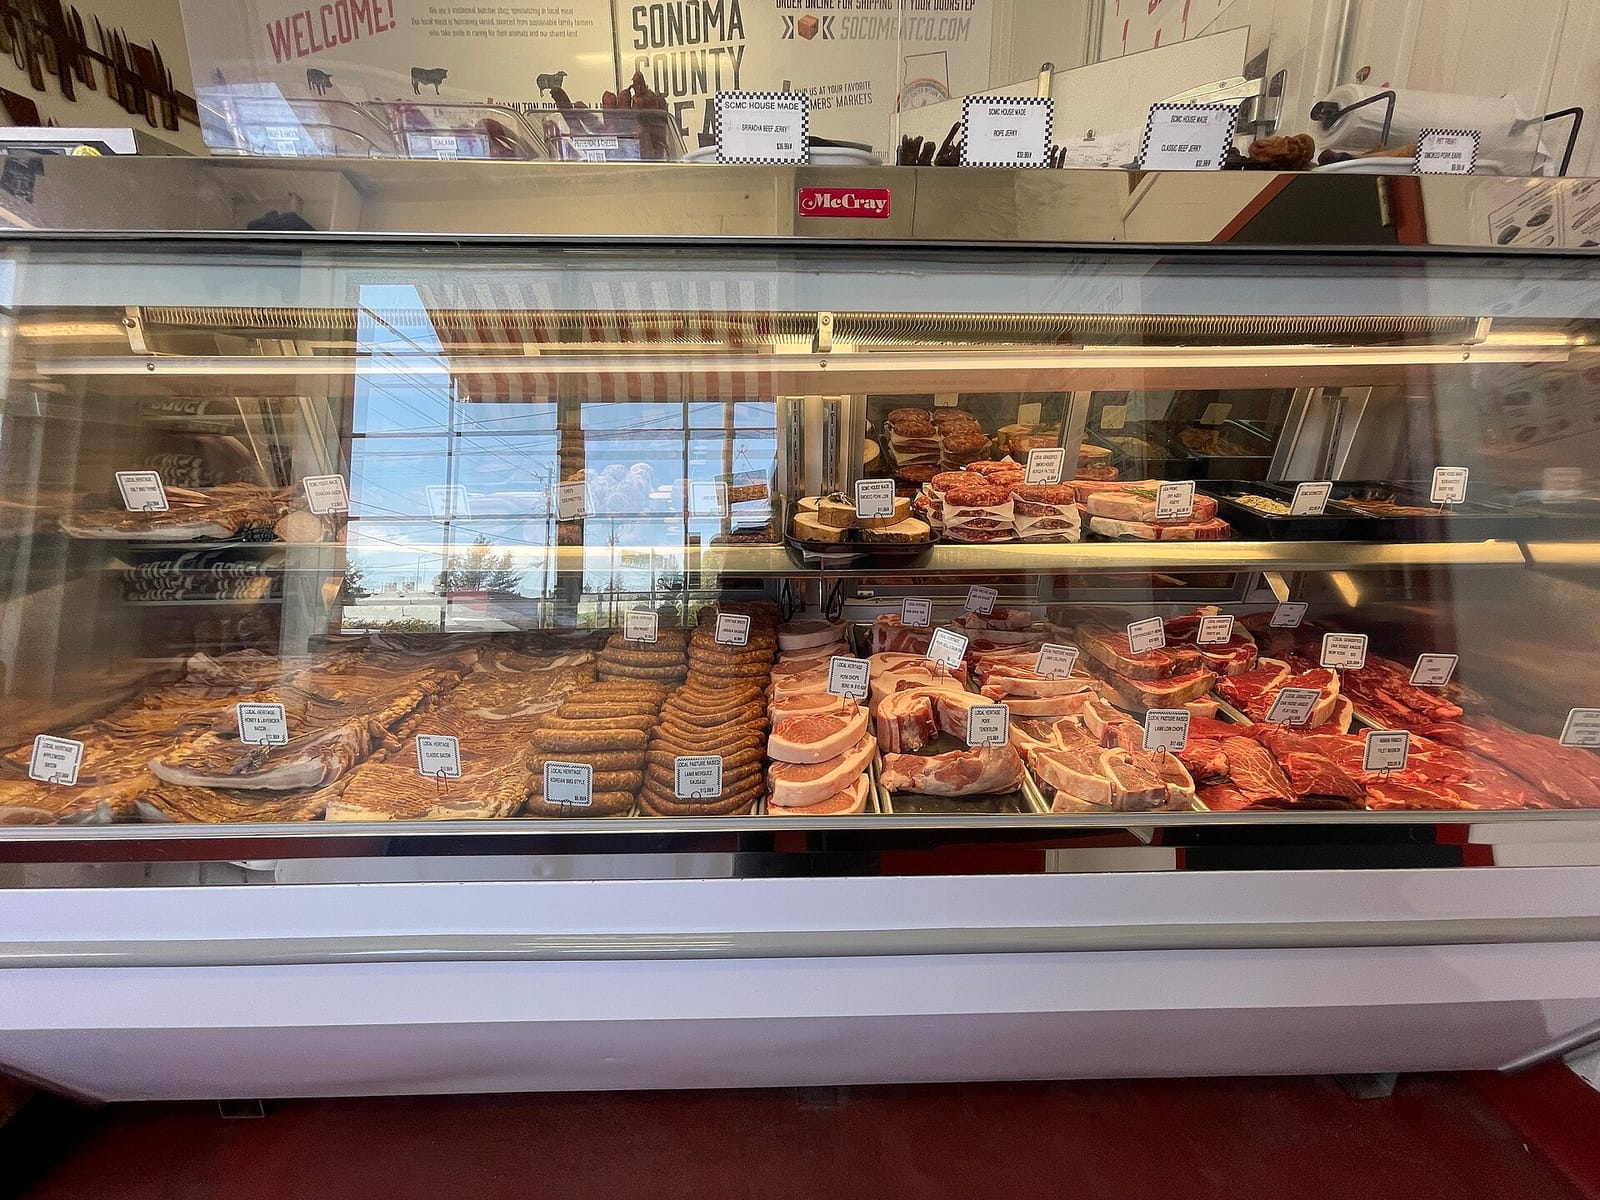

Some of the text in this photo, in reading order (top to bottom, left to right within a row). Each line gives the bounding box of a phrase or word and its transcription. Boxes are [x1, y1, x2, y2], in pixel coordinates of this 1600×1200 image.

[265, 0, 396, 64] WELCOME!
[632, 0, 746, 50] SONOMA
[810, 81, 872, 96] US AT YOUR FAVORITE
[724, 102, 799, 110] SCMC HOUSE MADE
[810, 93, 872, 110] MERS' MARKETS
[1197, 116, 1208, 124] MADE
[742, 124, 762, 132] SRIRACHA
[1161, 144, 1177, 152] CLASSIC
[1178, 144, 1188, 152] BEEF
[802, 193, 887, 213] McCray
